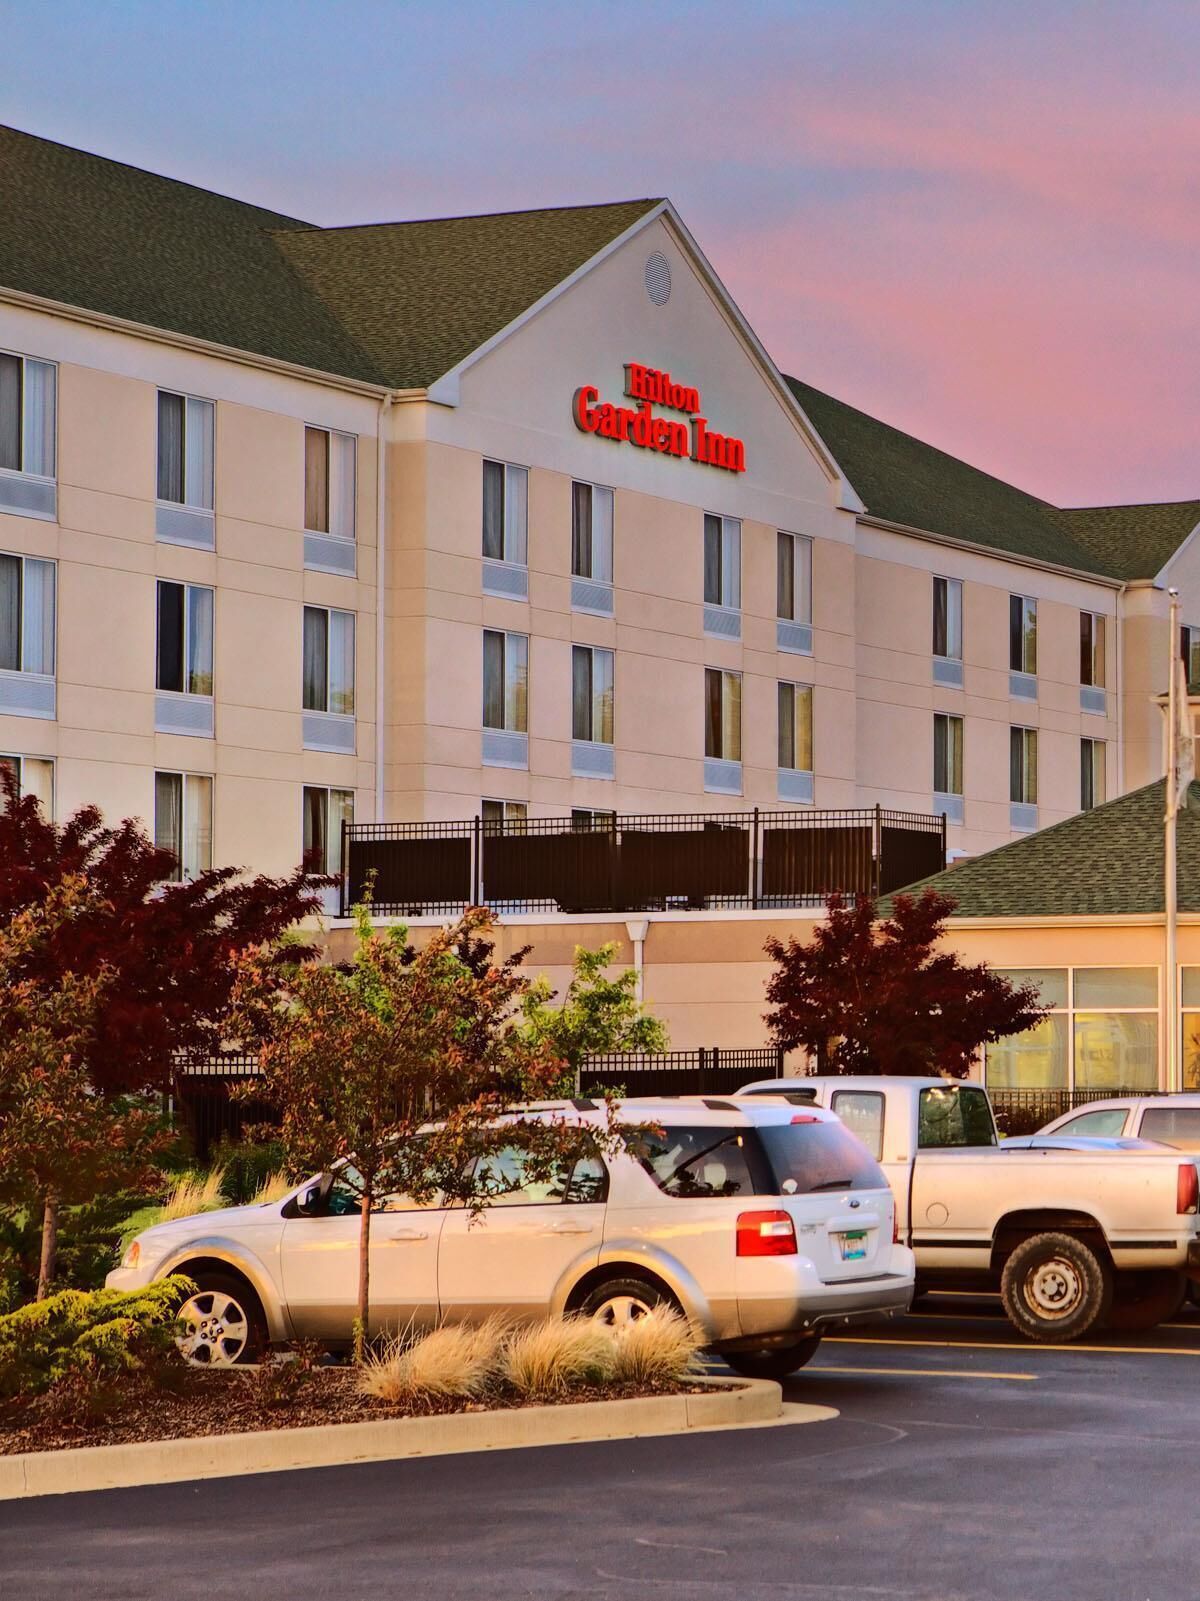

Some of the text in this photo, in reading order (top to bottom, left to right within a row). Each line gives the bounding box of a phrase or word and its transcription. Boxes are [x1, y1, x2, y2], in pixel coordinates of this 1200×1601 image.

[623, 362, 700, 414] Hilton
[572, 385, 746, 473] Garden Inn
